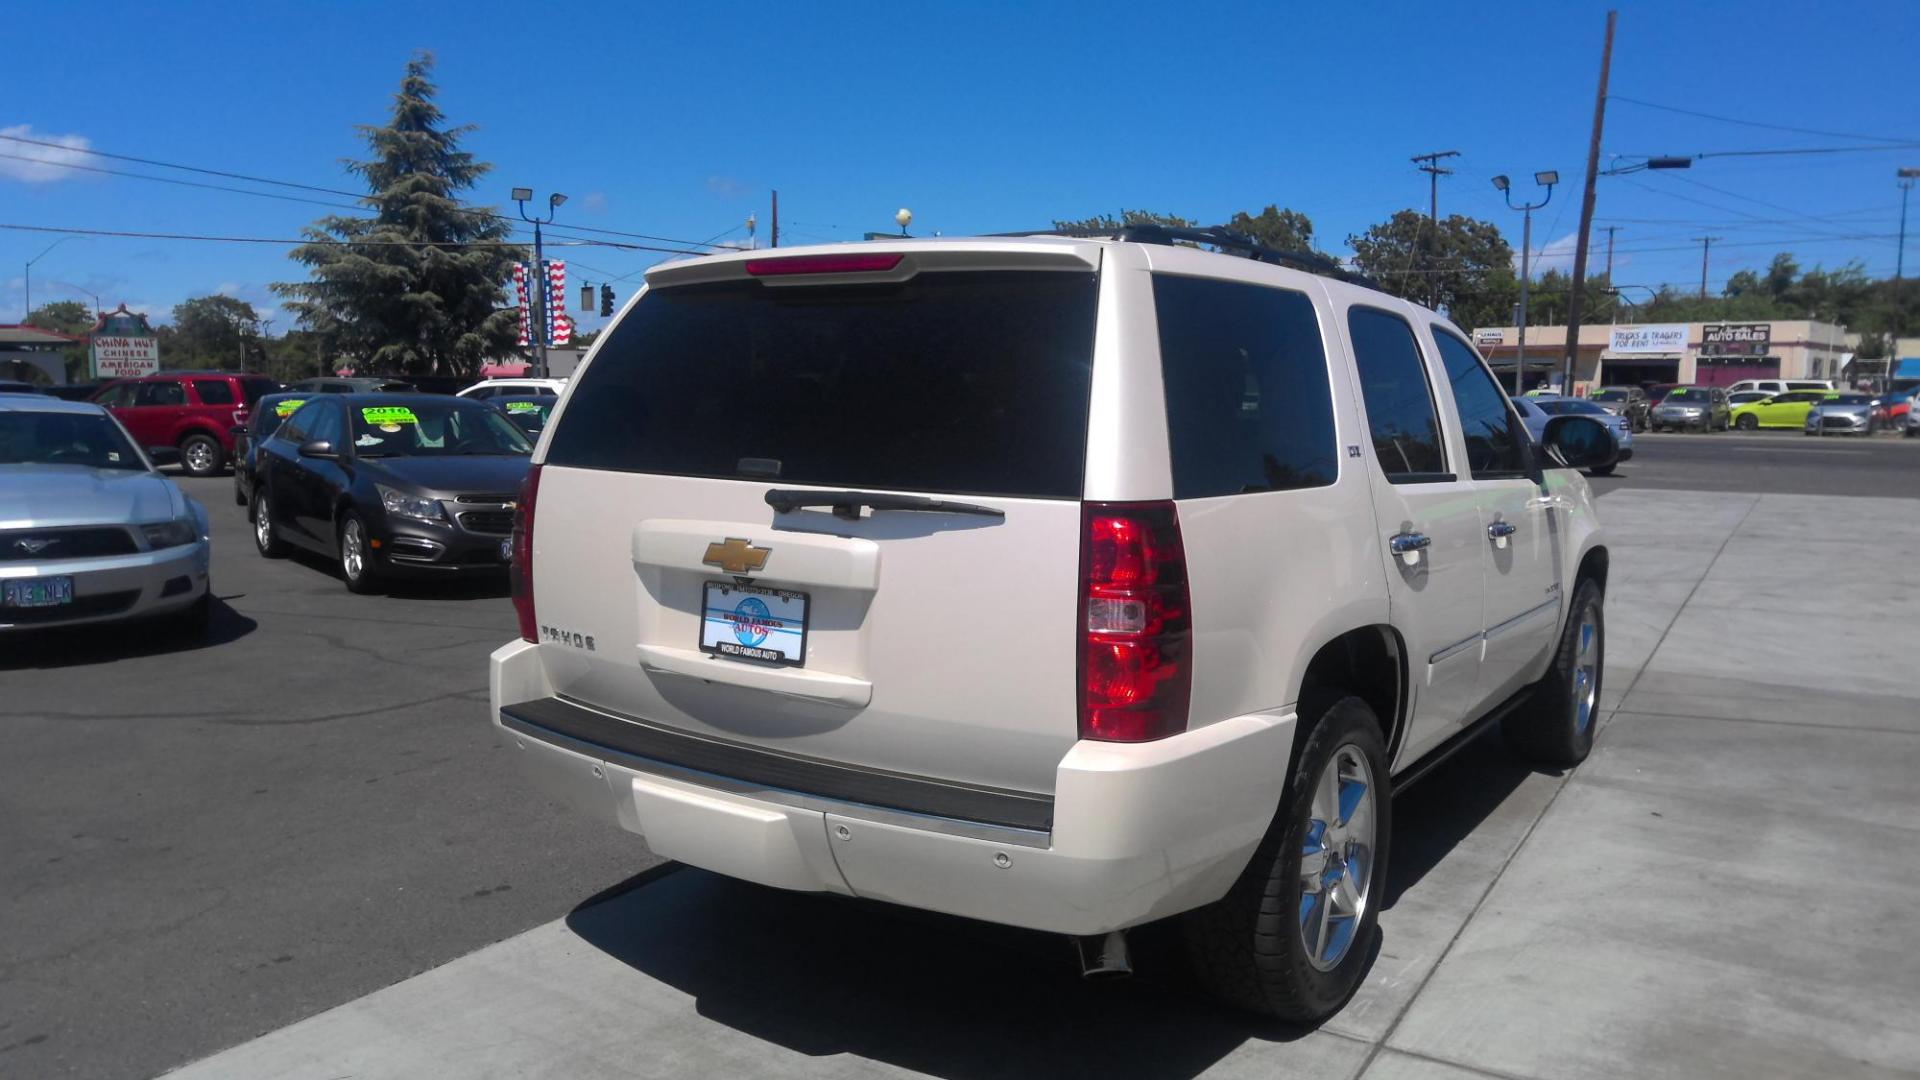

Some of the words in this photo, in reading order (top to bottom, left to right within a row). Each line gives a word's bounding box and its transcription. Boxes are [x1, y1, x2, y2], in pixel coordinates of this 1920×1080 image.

[1614, 331, 1641, 340] TRUCKS
[1707, 332, 1733, 342] AUTO
[1734, 331, 1767, 341] SALES
[96, 337, 129, 347] CHINA
[134, 338, 155, 347] HUT
[1615, 340, 1629, 348] FOR
[1631, 340, 1649, 348] RENT
[101, 361, 153, 369] AMERICAN
[723, 613, 750, 625] WORLD
[752, 616, 784, 628] FAMOUS
[735, 623, 769, 636] AUTOS
[721, 643, 740, 655] WORLD
[740, 646, 762, 658] FAMOUS
[762, 649, 778, 661] AUTO
